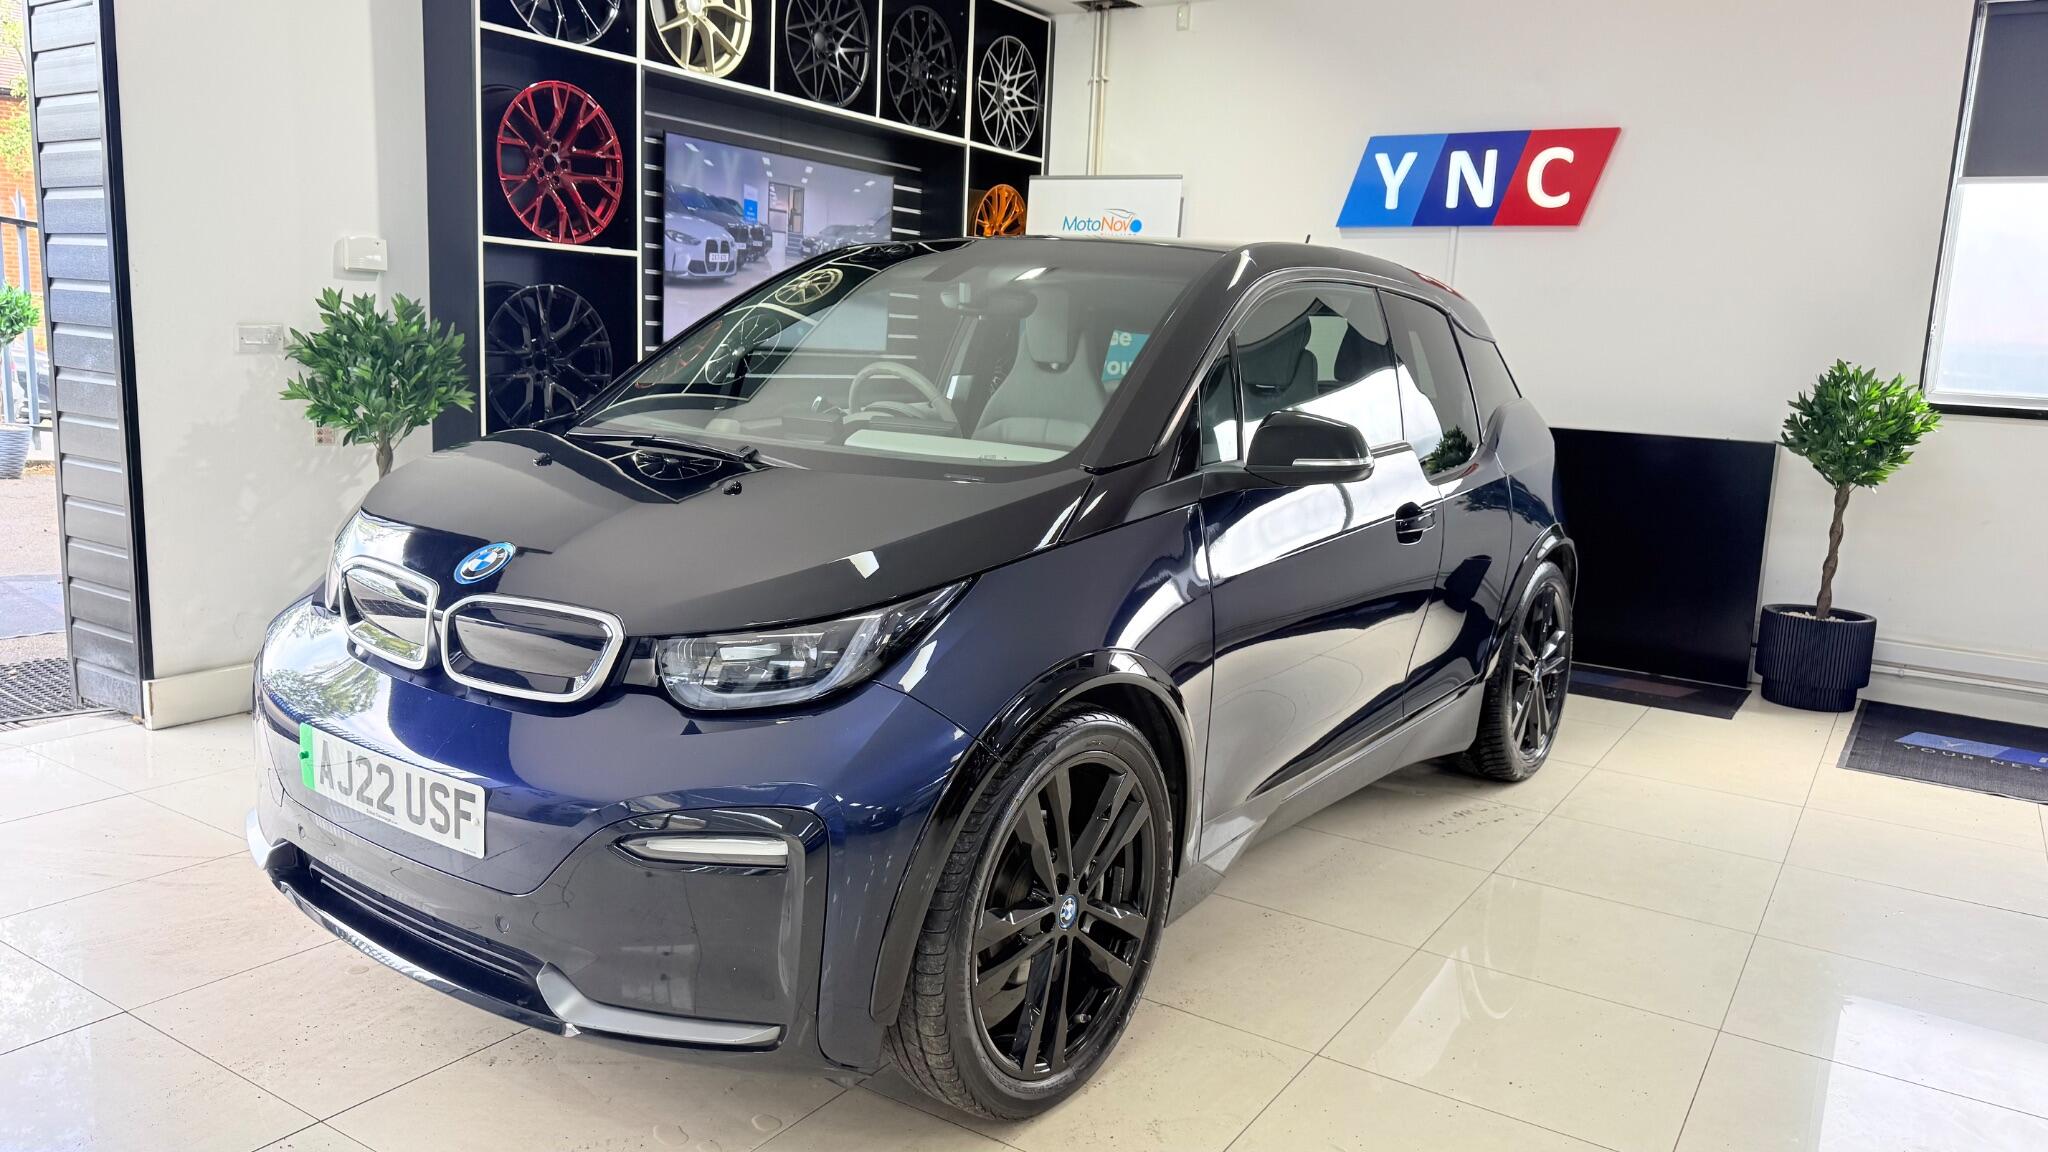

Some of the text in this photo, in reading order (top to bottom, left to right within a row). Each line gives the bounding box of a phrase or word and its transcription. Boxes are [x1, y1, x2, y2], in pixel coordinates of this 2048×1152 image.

[1375, 146, 1575, 210] YNC
[1903, 744, 1974, 760] YOUR
[319, 739, 477, 840] AJ22 USF
